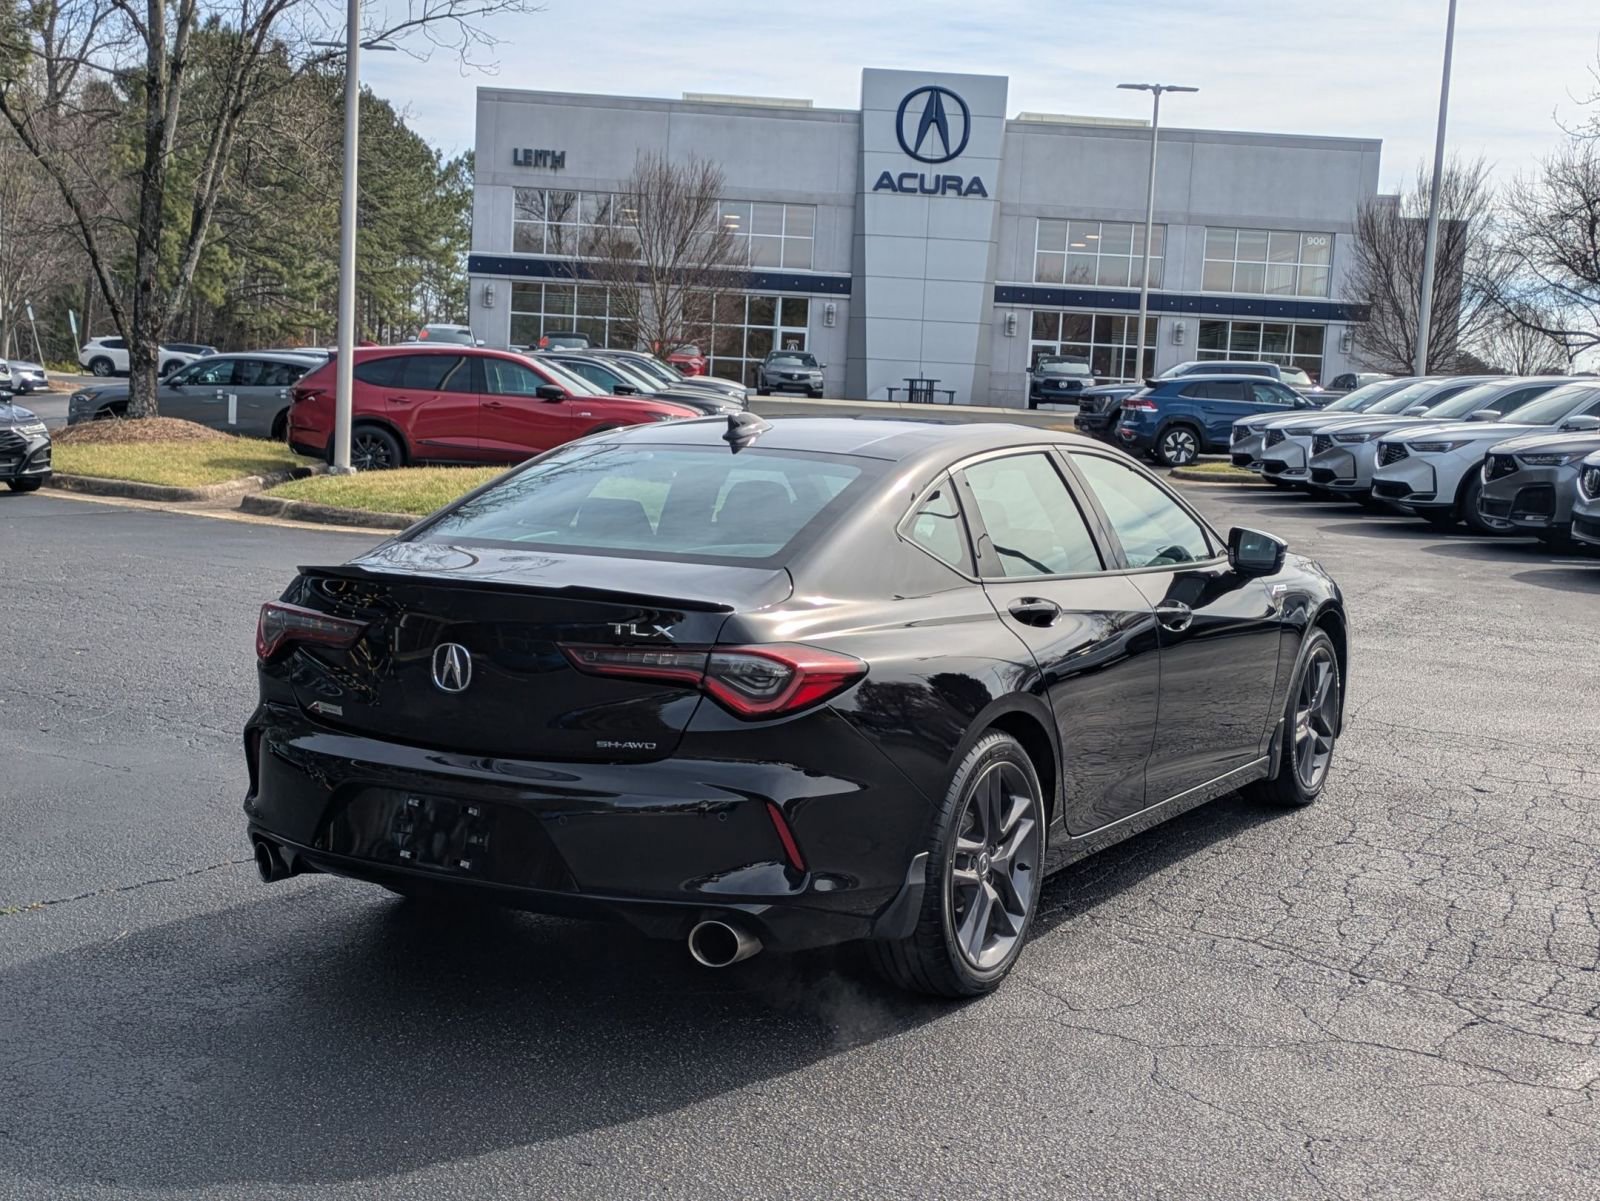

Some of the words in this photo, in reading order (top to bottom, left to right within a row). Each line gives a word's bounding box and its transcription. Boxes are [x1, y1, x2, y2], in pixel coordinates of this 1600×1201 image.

[513, 148, 566, 169] LEITH
[872, 171, 989, 198] ACURA
[1307, 236, 1326, 246] 900
[607, 622, 675, 639] TLX
[596, 740, 657, 750] SH-AWD
